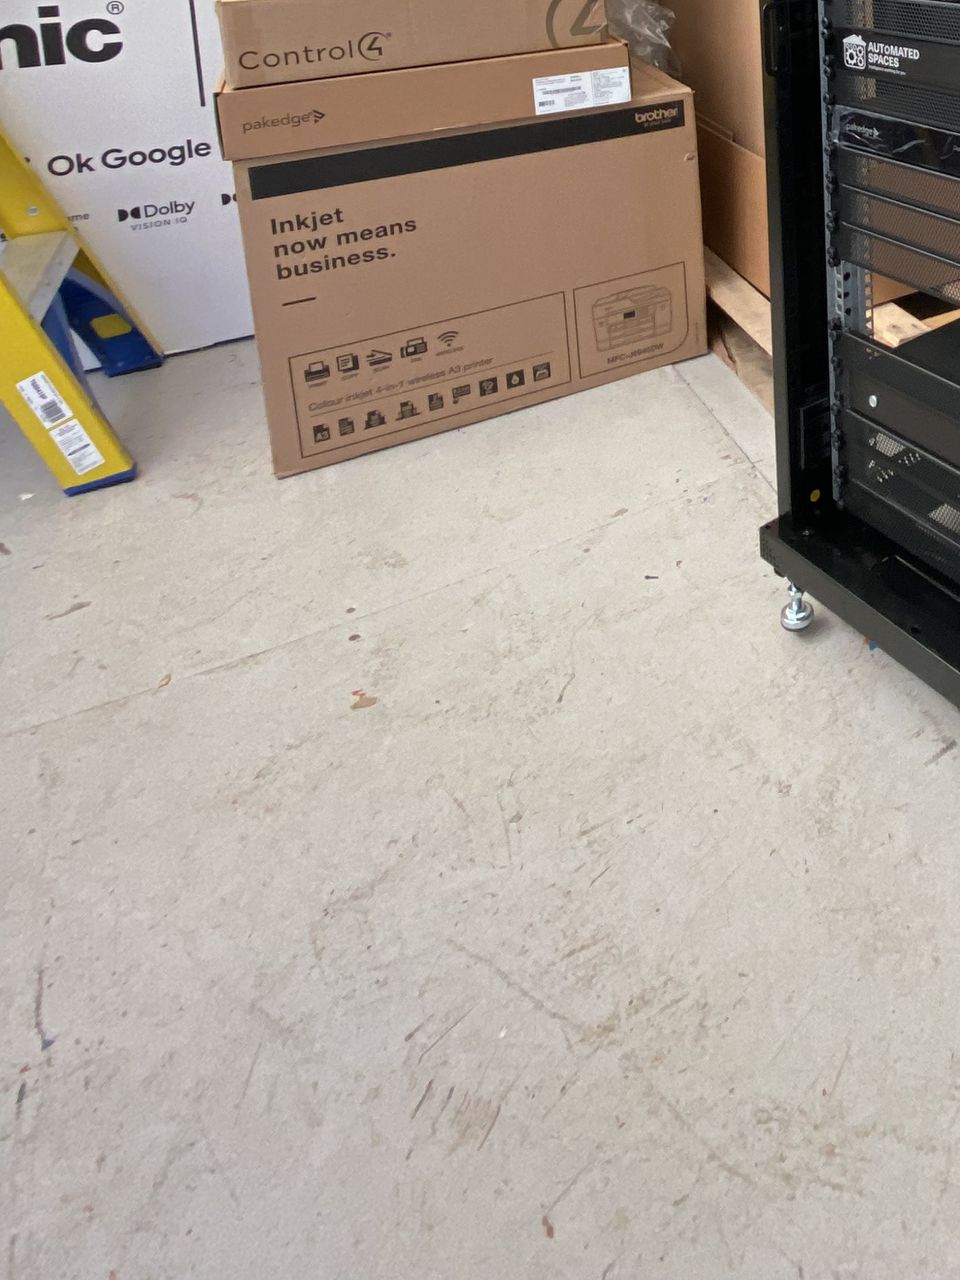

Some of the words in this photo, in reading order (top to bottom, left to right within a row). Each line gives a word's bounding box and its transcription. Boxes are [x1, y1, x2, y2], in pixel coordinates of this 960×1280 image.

[867, 42, 920, 60] AUTOMATED
[867, 54, 900, 68] SPACES
[242, 112, 310, 134] pakedge
[635, 107, 677, 124] brother
[48, 153, 96, 176] Ok
[101, 138, 211, 169] Google
[143, 201, 196, 218] Dolby
[130, 219, 171, 231] VISION
[270, 208, 344, 235] Inkjet
[273, 236, 328, 257] now
[336, 219, 417, 246] means
[276, 246, 396, 280] business.
[308, 396, 344, 411] Colour
[345, 387, 373, 403] inkjet
[407, 370, 446, 386] wireless
[462, 357, 494, 373] printer
